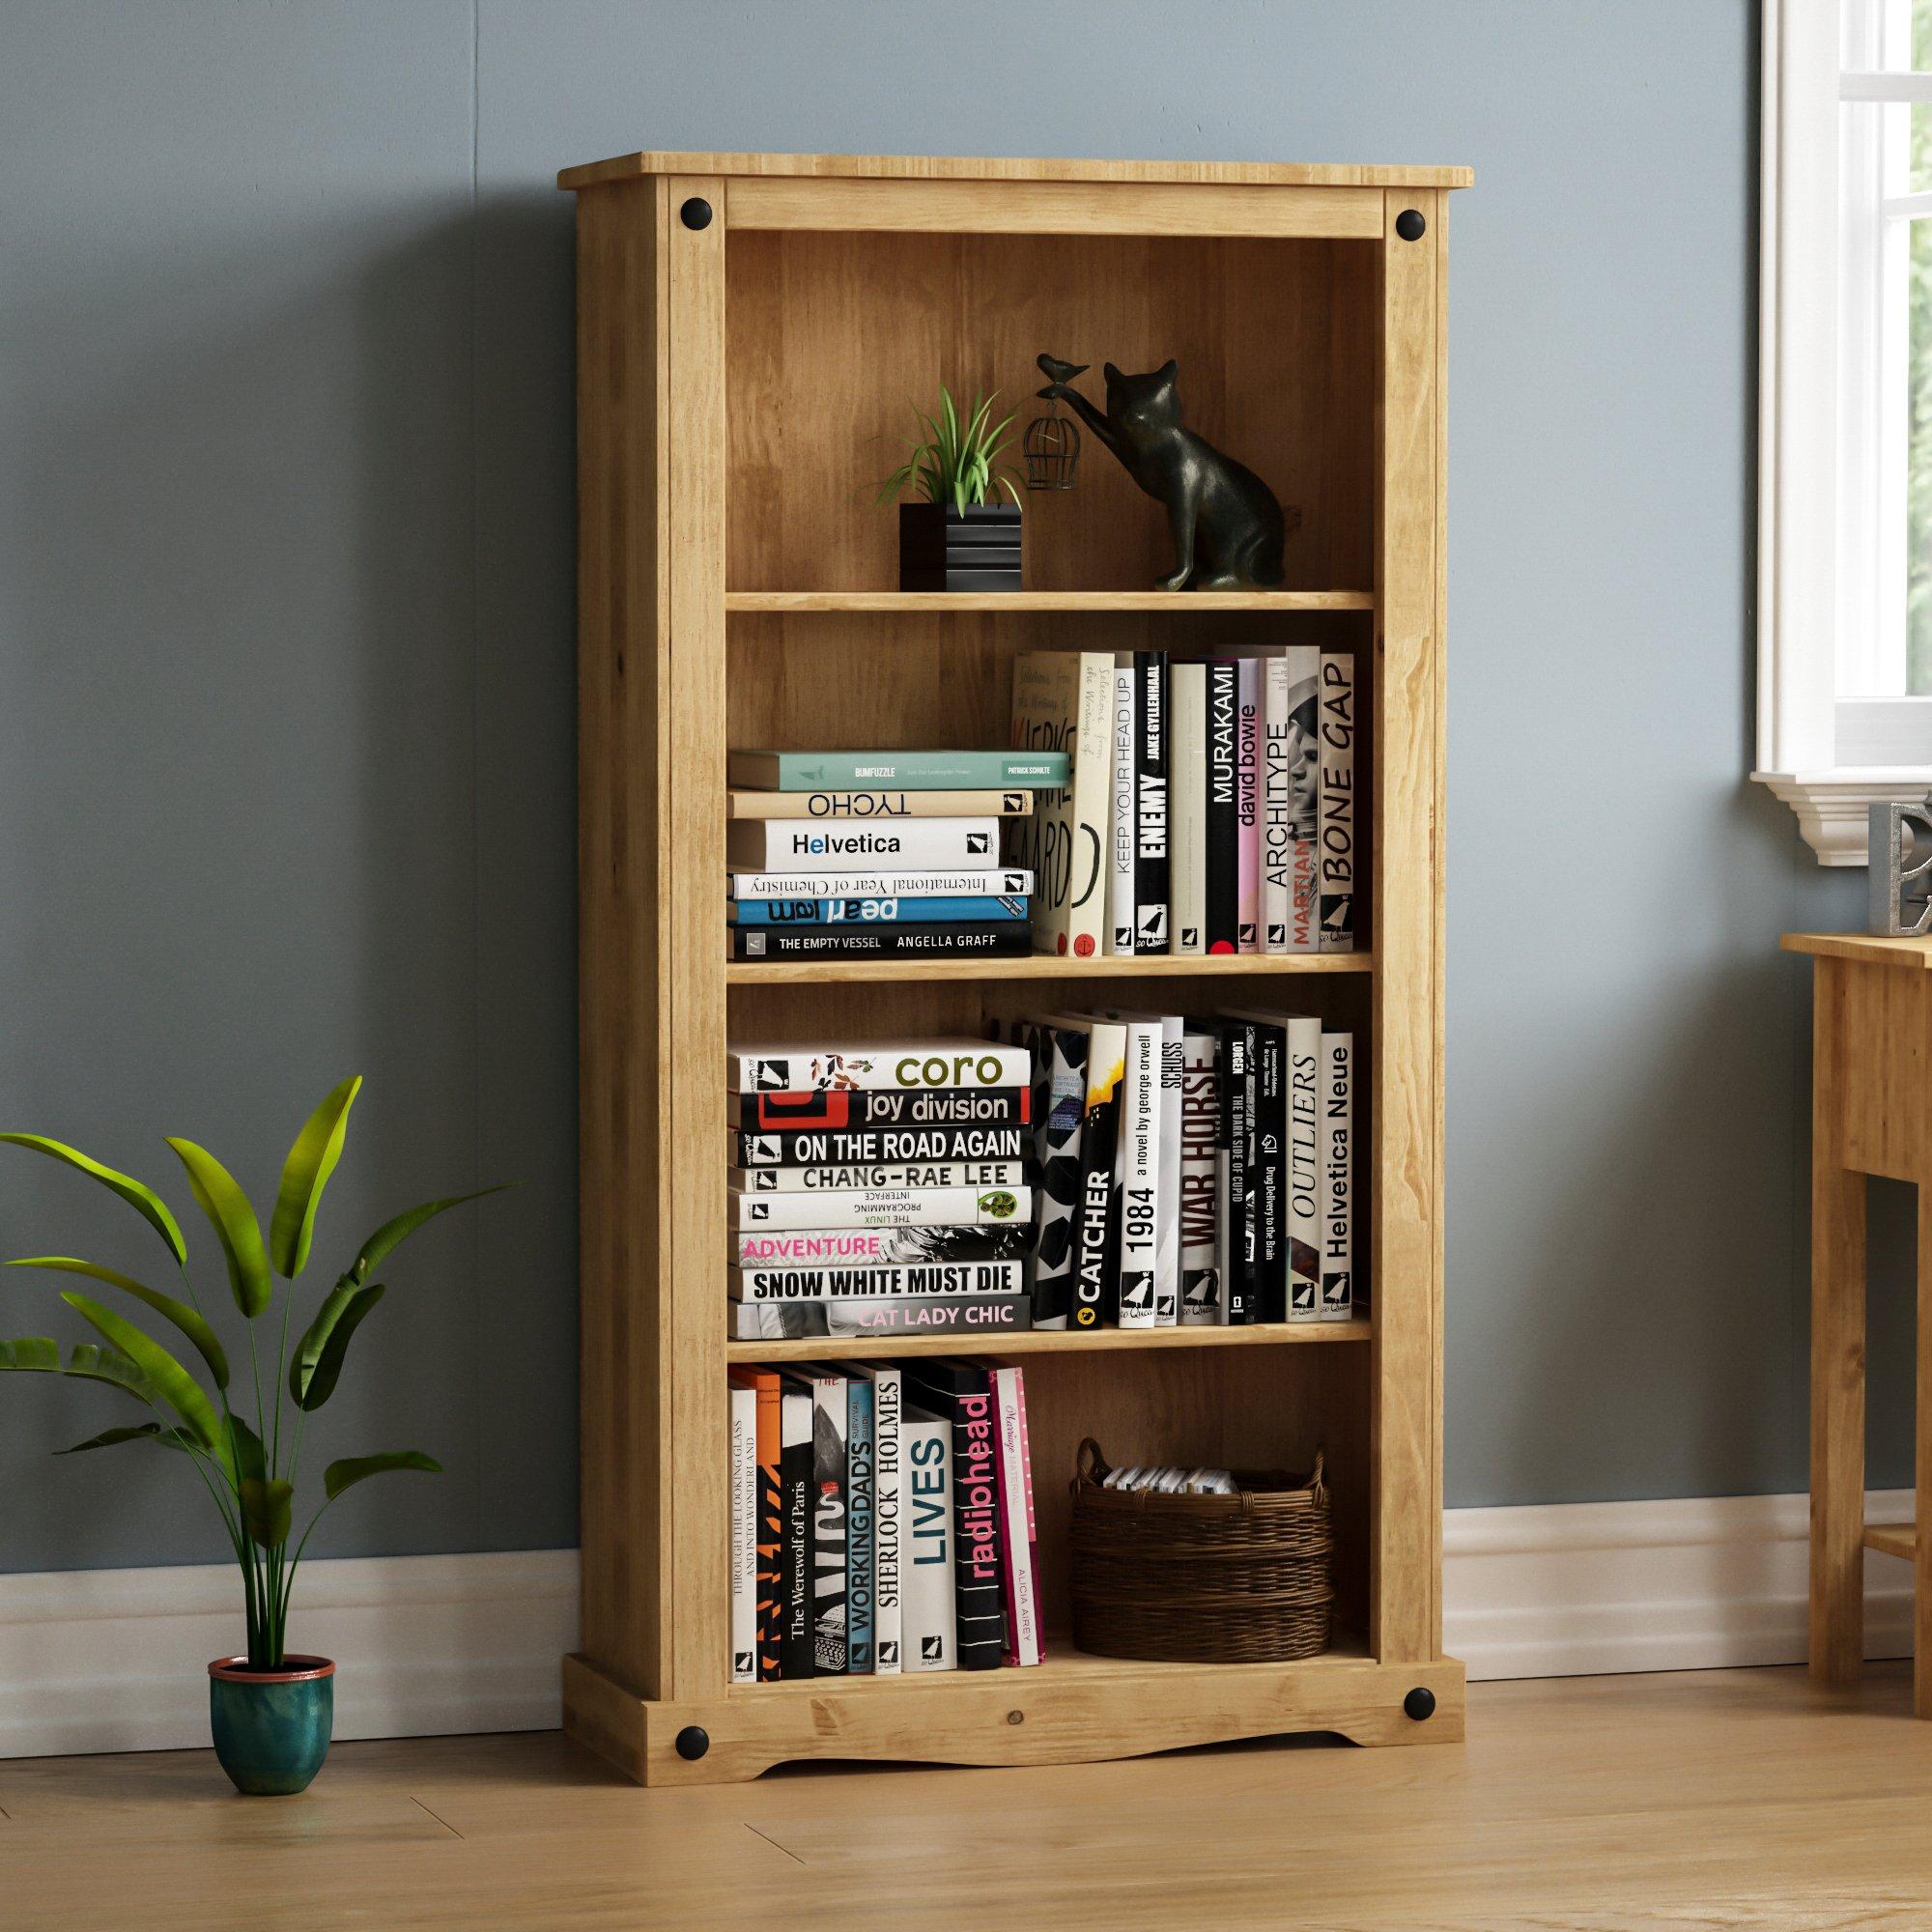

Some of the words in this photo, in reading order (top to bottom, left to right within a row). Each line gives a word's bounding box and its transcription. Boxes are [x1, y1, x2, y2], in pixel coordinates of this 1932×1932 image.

[1117, 676, 1131, 703] UP
[1147, 665, 1160, 731] GYLLENHAAL
[1321, 662, 1354, 751] GAP
[1117, 709, 1131, 761] HEAD
[1147, 732, 1160, 760] JAKE
[1213, 666, 1234, 804] MURAKAMI
[1238, 704, 1256, 766] bowie
[854, 766, 895, 779] BUMFUZZLE
[808, 793, 911, 816] TYCHO
[1117, 767, 1131, 821] YOUR
[1237, 773, 1256, 828] david
[1266, 723, 1288, 888] ARCHITYPE
[1139, 774, 1167, 859] ENEMY
[1322, 767, 1353, 883] BONE
[792, 833, 901, 854] Helvetica
[1117, 826, 1131, 874] KEEP
[750, 877, 828, 895] Chemistry
[835, 878, 849, 894] of
[853, 878, 888, 894] Year
[894, 877, 986, 893] International
[1293, 839, 1310, 946] MARTIAN
[827, 897, 898, 923] pearl
[780, 938, 802, 950] THE
[803, 938, 839, 949] EMPTY
[841, 937, 881, 949] VESSEL
[896, 935, 952, 948] ANGELLA
[956, 934, 996, 947] GRAFF
[1138, 1035, 1151, 1070] orwell
[1161, 1041, 1182, 1089] SCHUSS
[1232, 1041, 1243, 1074] LORGEN
[895, 1055, 1003, 1087] coro
[1327, 1046, 1349, 1118] Neue
[865, 1091, 904, 1122] joy
[912, 1092, 1009, 1121] division
[1138, 1074, 1151, 1114] george
[1181, 1056, 1216, 1161] HORSE
[1231, 1094, 1243, 1111] THE
[1136, 1117, 1151, 1130] by
[1231, 1114, 1243, 1137] DARK
[1292, 1054, 1317, 1219] OUTLIERS
[794, 1134, 827, 1162] ON
[834, 1133, 876, 1160] THE
[884, 1131, 947, 1159] ROAD
[952, 1129, 1020, 1157] AGAIN
[1135, 1134, 1148, 1166] novel
[1231, 1140, 1243, 1160] SIDE
[803, 1166, 952, 1188] CHANG-RAE
[964, 1164, 1008, 1184] LEE
[1231, 1162, 1243, 1174] OF
[1264, 1166, 1275, 1185] Drug
[865, 1191, 910, 1201] INTERFACE
[1231, 1176, 1243, 1203] CUPID
[1264, 1185, 1275, 1215] Delivery
[1326, 1127, 1349, 1258] Helvetica
[853, 1203, 922, 1213] PROGRAMMING
[865, 1215, 891, 1224] LINUX
[894, 1215, 911, 1224] THE
[1126, 1187, 1154, 1254] 1984
[1181, 1174, 1216, 1248] WAR
[1265, 1217, 1275, 1226] to
[743, 1236, 880, 1258] ADVENTURE
[1077, 1170, 1110, 1304] CATCHER
[1265, 1226, 1275, 1239] the
[1265, 1240, 1275, 1261] Brain
[753, 1271, 824, 1298] SNOW
[828, 1268, 902, 1295] WHITE
[907, 1266, 971, 1293] MUST
[976, 1265, 1011, 1291] DIE
[858, 1309, 897, 1327] CAT
[903, 1306, 959, 1326] LADY
[964, 1305, 1014, 1325] CHIC
[733, 1419, 742, 1458] GLASS
[877, 1380, 899, 1475] HOLMES
[733, 1459, 742, 1513] LOOKING
[746, 1436, 754, 1520] WONDERLAND
[958, 1393, 996, 1579] radiohead
[791, 1481, 805, 1517] Paris
[910, 1436, 948, 1567] LIVES
[733, 1514, 742, 1537] THE
[746, 1522, 754, 1550] INTO
[791, 1520, 805, 1535] of
[877, 1486, 899, 1608] SHERLOCK
[733, 1540, 742, 1596] THROUGH
[746, 1552, 754, 1577] AND
[791, 1536, 805, 1605] Werewolf
[851, 1515, 870, 1633] WORKING
[1018, 1568, 1029, 1604] ALICIA
[791, 1609, 805, 1640] The
[1021, 1605, 1032, 1642] AIREY
